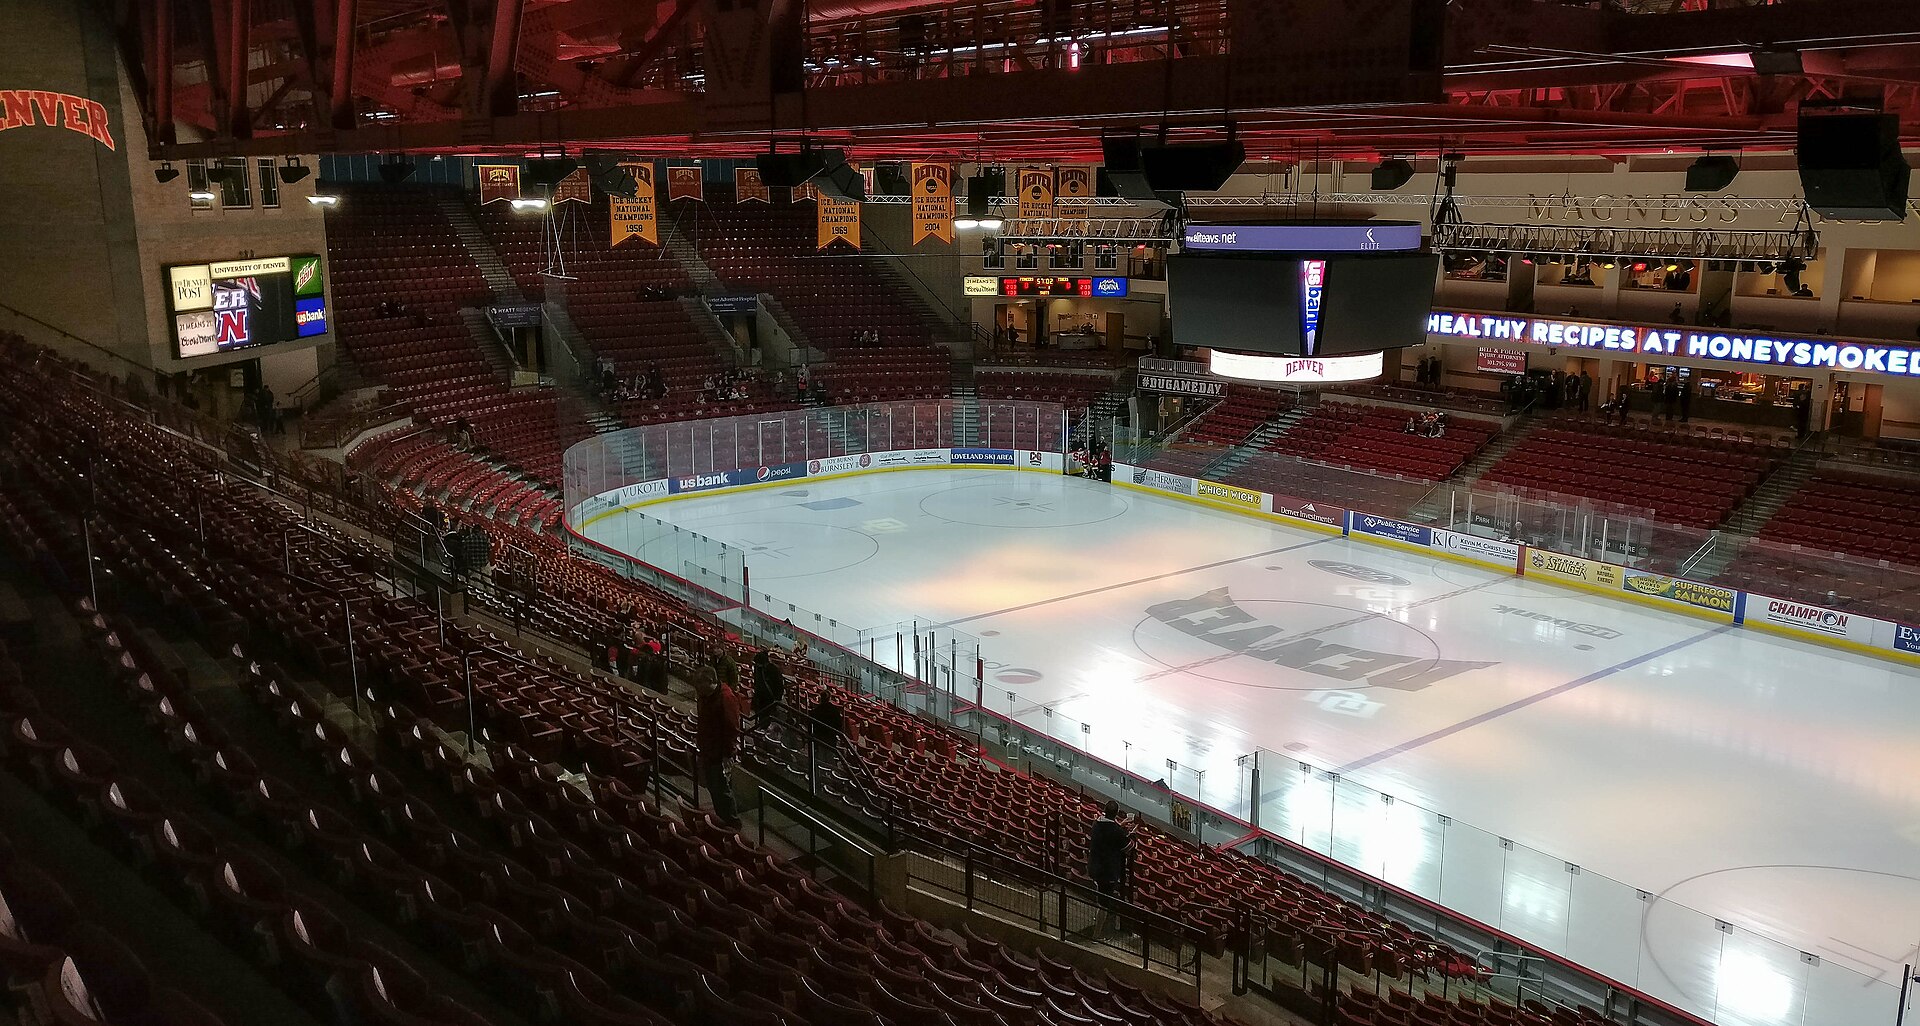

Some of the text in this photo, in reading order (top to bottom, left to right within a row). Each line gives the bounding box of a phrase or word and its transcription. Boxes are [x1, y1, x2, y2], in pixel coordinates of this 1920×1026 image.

[0, 89, 115, 152] NVER
[914, 164, 949, 187] DENVER
[1021, 173, 1051, 195] DENVER
[821, 198, 832, 206] ICE
[616, 204, 650, 212] NATIONAL
[823, 206, 855, 214] NATIONAL
[1527, 193, 1740, 224] MAGNESS
[614, 212, 653, 221] CHAMPIONS
[821, 215, 857, 223] CHAMPIONS
[625, 224, 643, 233] 1958
[831, 226, 848, 235] 1969
[924, 222, 941, 231] 2004
[1360, 242, 1380, 250] ELITE
[214, 265, 252, 275] UNIVERSITY
[262, 261, 286, 270] DENVER
[178, 286, 202, 300] POST
[1427, 313, 1527, 340] HEALTHY
[1532, 322, 1636, 351] RECIPES
[1642, 331, 1682, 354] AT
[1500, 348, 1525, 356] POLLOCK
[1496, 353, 1525, 361] ATTORNEYS
[1285, 359, 1324, 377] DENVER
[1142, 377, 1222, 395] #DUGAMEDAY
[951, 453, 983, 461] LOVELAND
[984, 453, 995, 461] SKI
[995, 453, 1014, 461] AREA
[770, 466, 791, 478] pepsi
[821, 463, 854, 473] BURNSLEY
[622, 481, 666, 498] VUKOTA
[1198, 482, 1229, 497] WHICH
[1229, 489, 1254, 503] WICH
[1280, 506, 1335, 524] Denver Investments
[1475, 515, 1490, 524] PARK
[1376, 519, 1420, 534] Public Service
[1460, 538, 1476, 546] KEVIN
[1594, 538, 1636, 553] PAK HRE
[1546, 558, 1588, 580] STINGER
[1600, 564, 1612, 572] PURE
[1596, 570, 1615, 579] NATURAL
[1596, 576, 1614, 585] ENERGY
[1636, 580, 1661, 589] SMOKED
[1636, 585, 1661, 593] SALMON
[1674, 588, 1731, 610] SALMON
